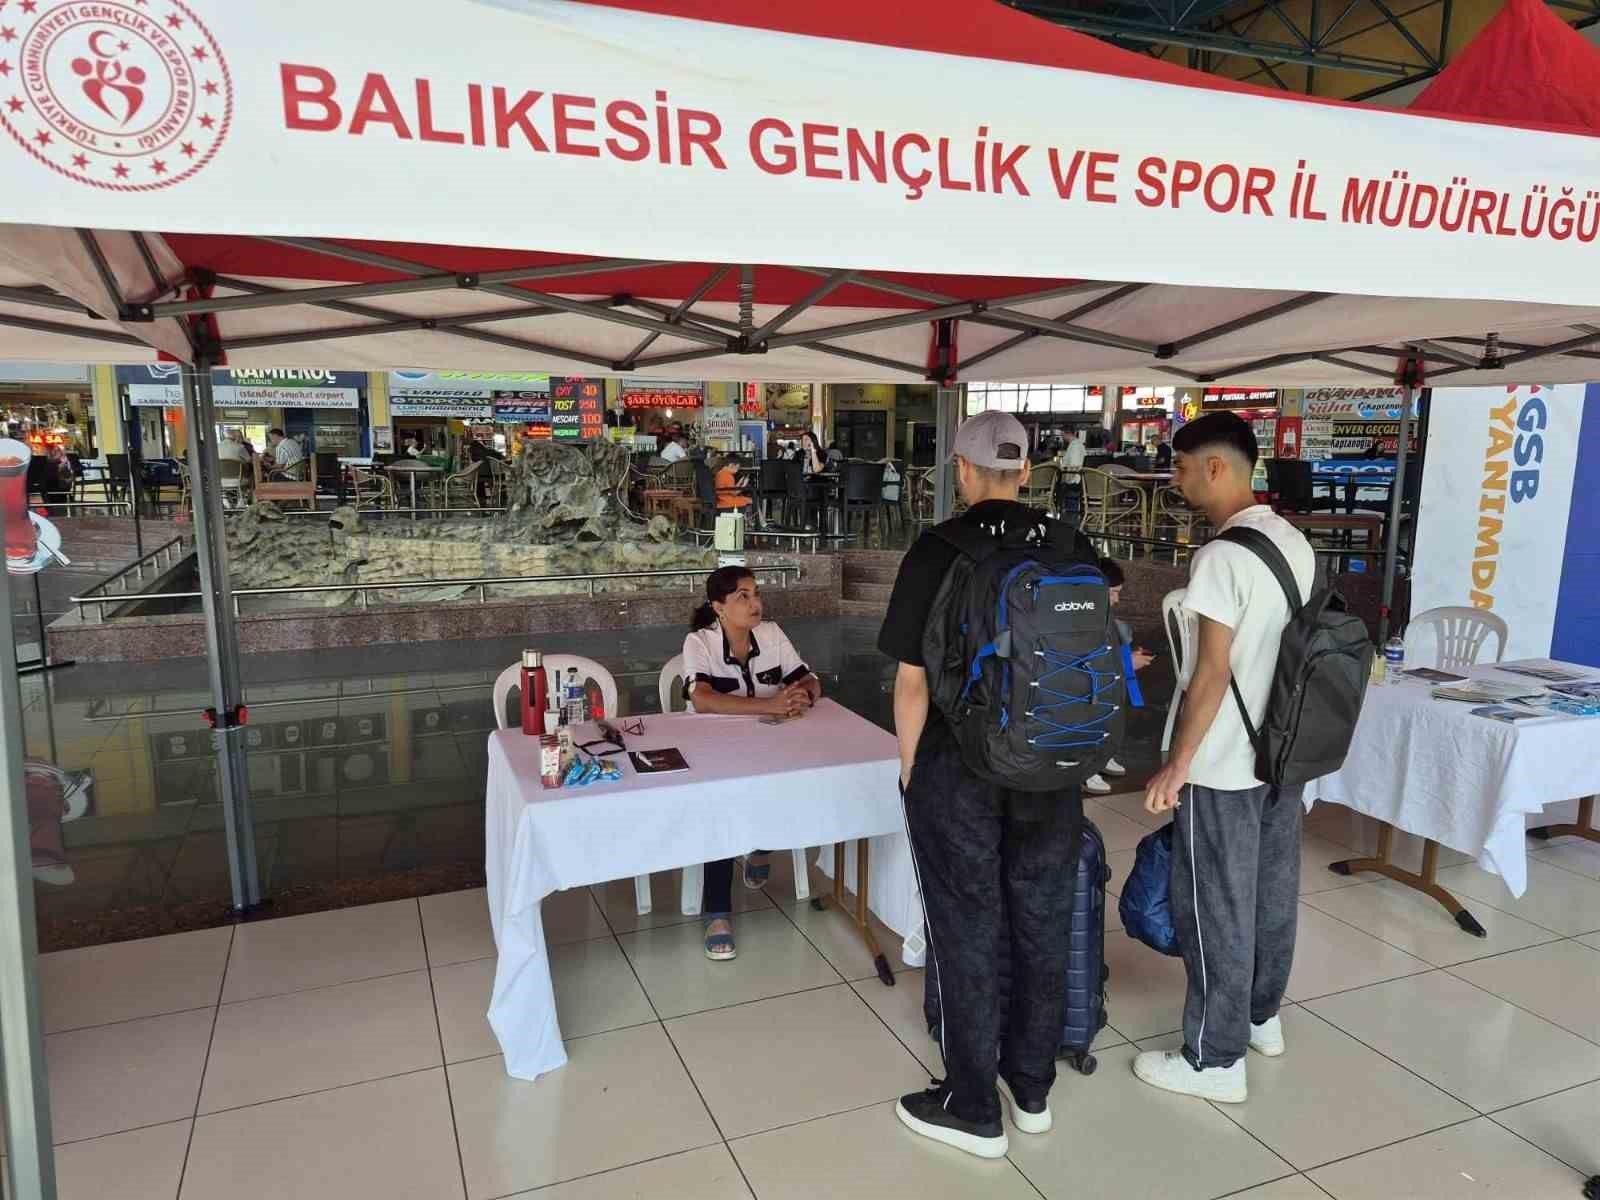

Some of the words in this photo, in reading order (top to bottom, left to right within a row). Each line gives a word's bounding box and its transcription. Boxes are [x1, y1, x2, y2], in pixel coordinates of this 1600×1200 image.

[79, 5, 149, 32] GENÇLİK
[150, 29, 170, 49] VE
[27, 7, 78, 92] CUMHURİYETİ
[164, 49, 189, 88] SPOR
[37, 94, 97, 146] TÜRKİYE
[137, 90, 189, 149] BAKANLIĞI
[280, 63, 726, 171] BALIKESİR
[748, 117, 1030, 200] GENÇLİK
[1048, 147, 1120, 204] VE
[1135, 155, 1277, 216] SPOR
[1289, 160, 1327, 221] İL
[1342, 171, 1600, 243] MÜDÜRLÜĞÜ
[554, 399, 576, 410] TOST
[1510, 397, 1548, 504] GSB
[1054, 600, 1097, 612] abbvie
